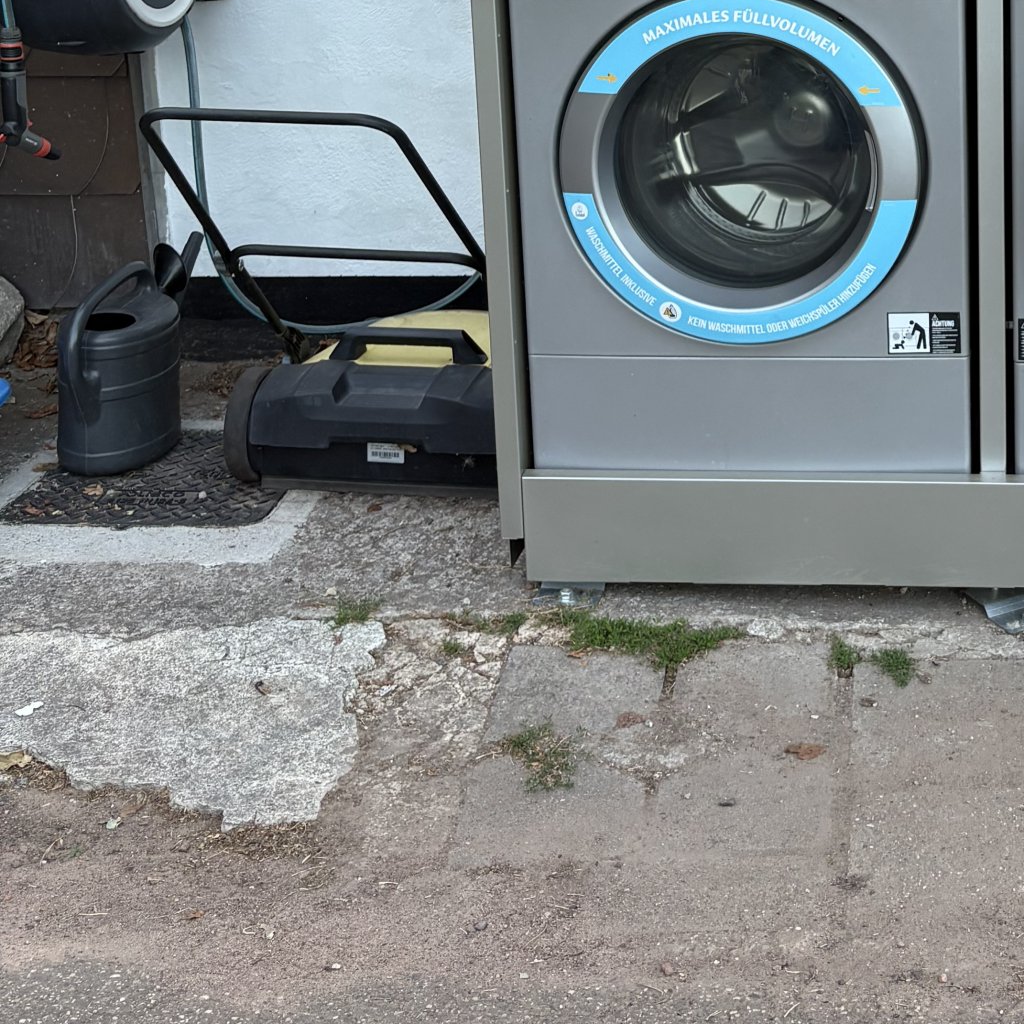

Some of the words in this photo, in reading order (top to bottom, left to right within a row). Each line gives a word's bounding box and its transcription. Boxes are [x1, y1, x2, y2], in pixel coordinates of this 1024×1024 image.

[642, 10, 730, 45] MAXIMALES
[733, 8, 841, 57] FÜLLVOLUMEN
[585, 226, 623, 278] WASCHMITTEL
[620, 274, 657, 306] INKLUSIVE
[688, 315, 707, 329] KEIN
[708, 320, 765, 335] WASCHMITTEL
[766, 320, 788, 334] ODER
[788, 298, 841, 329] WEICHSPÜLER
[839, 263, 877, 303] HINZUFÜGEN
